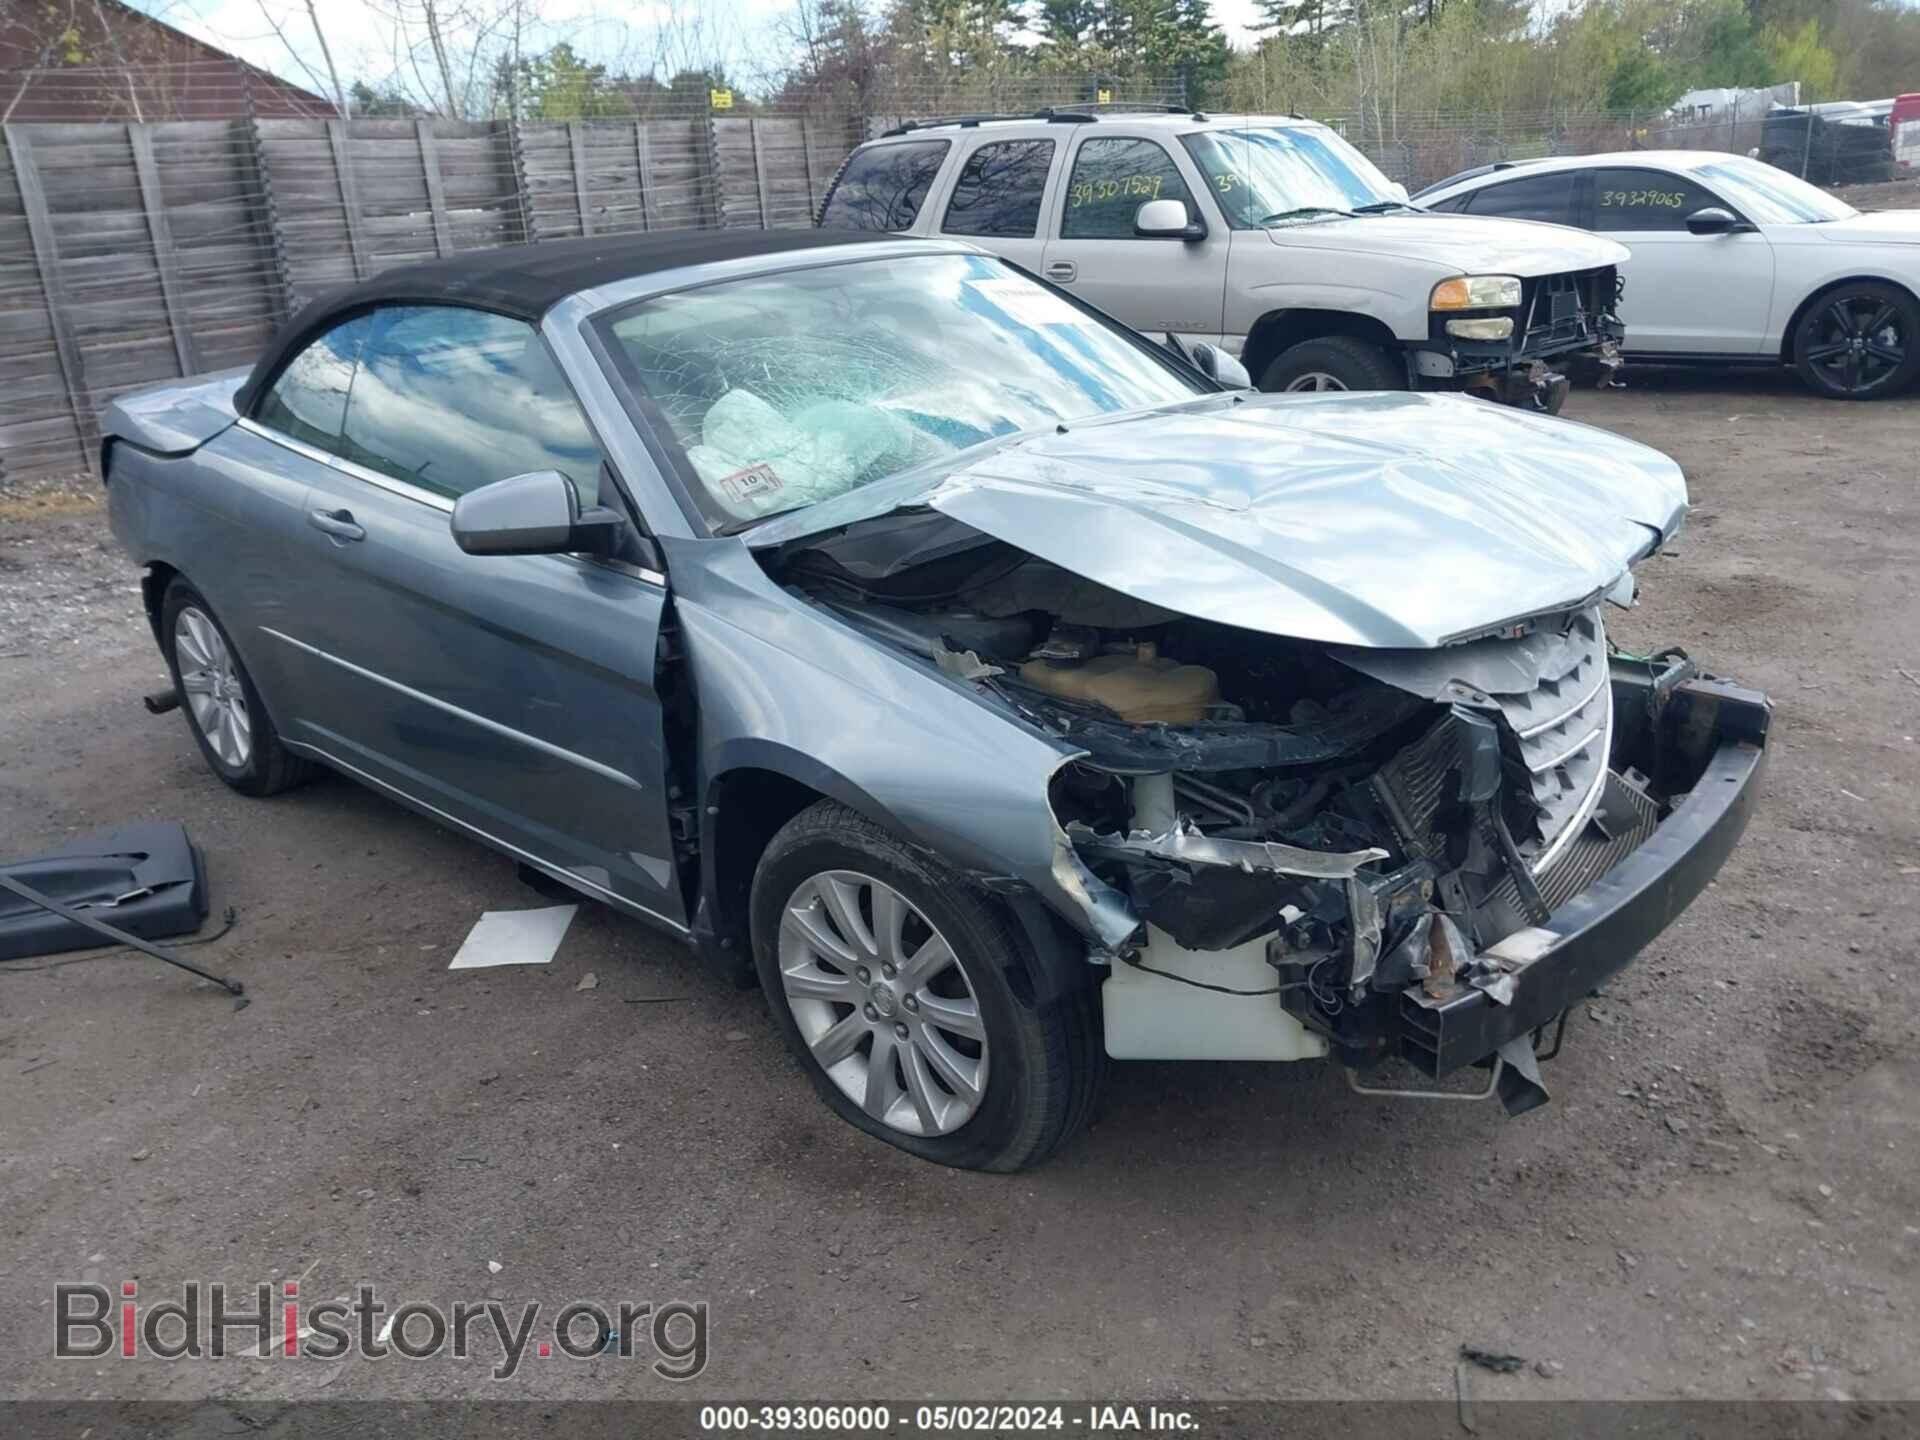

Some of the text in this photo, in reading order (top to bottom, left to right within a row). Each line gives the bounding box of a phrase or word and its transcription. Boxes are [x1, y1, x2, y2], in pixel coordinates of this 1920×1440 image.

[1072, 175, 1163, 207] 39307529
[1600, 190, 1685, 208] 39329065
[741, 475, 757, 486] 10
